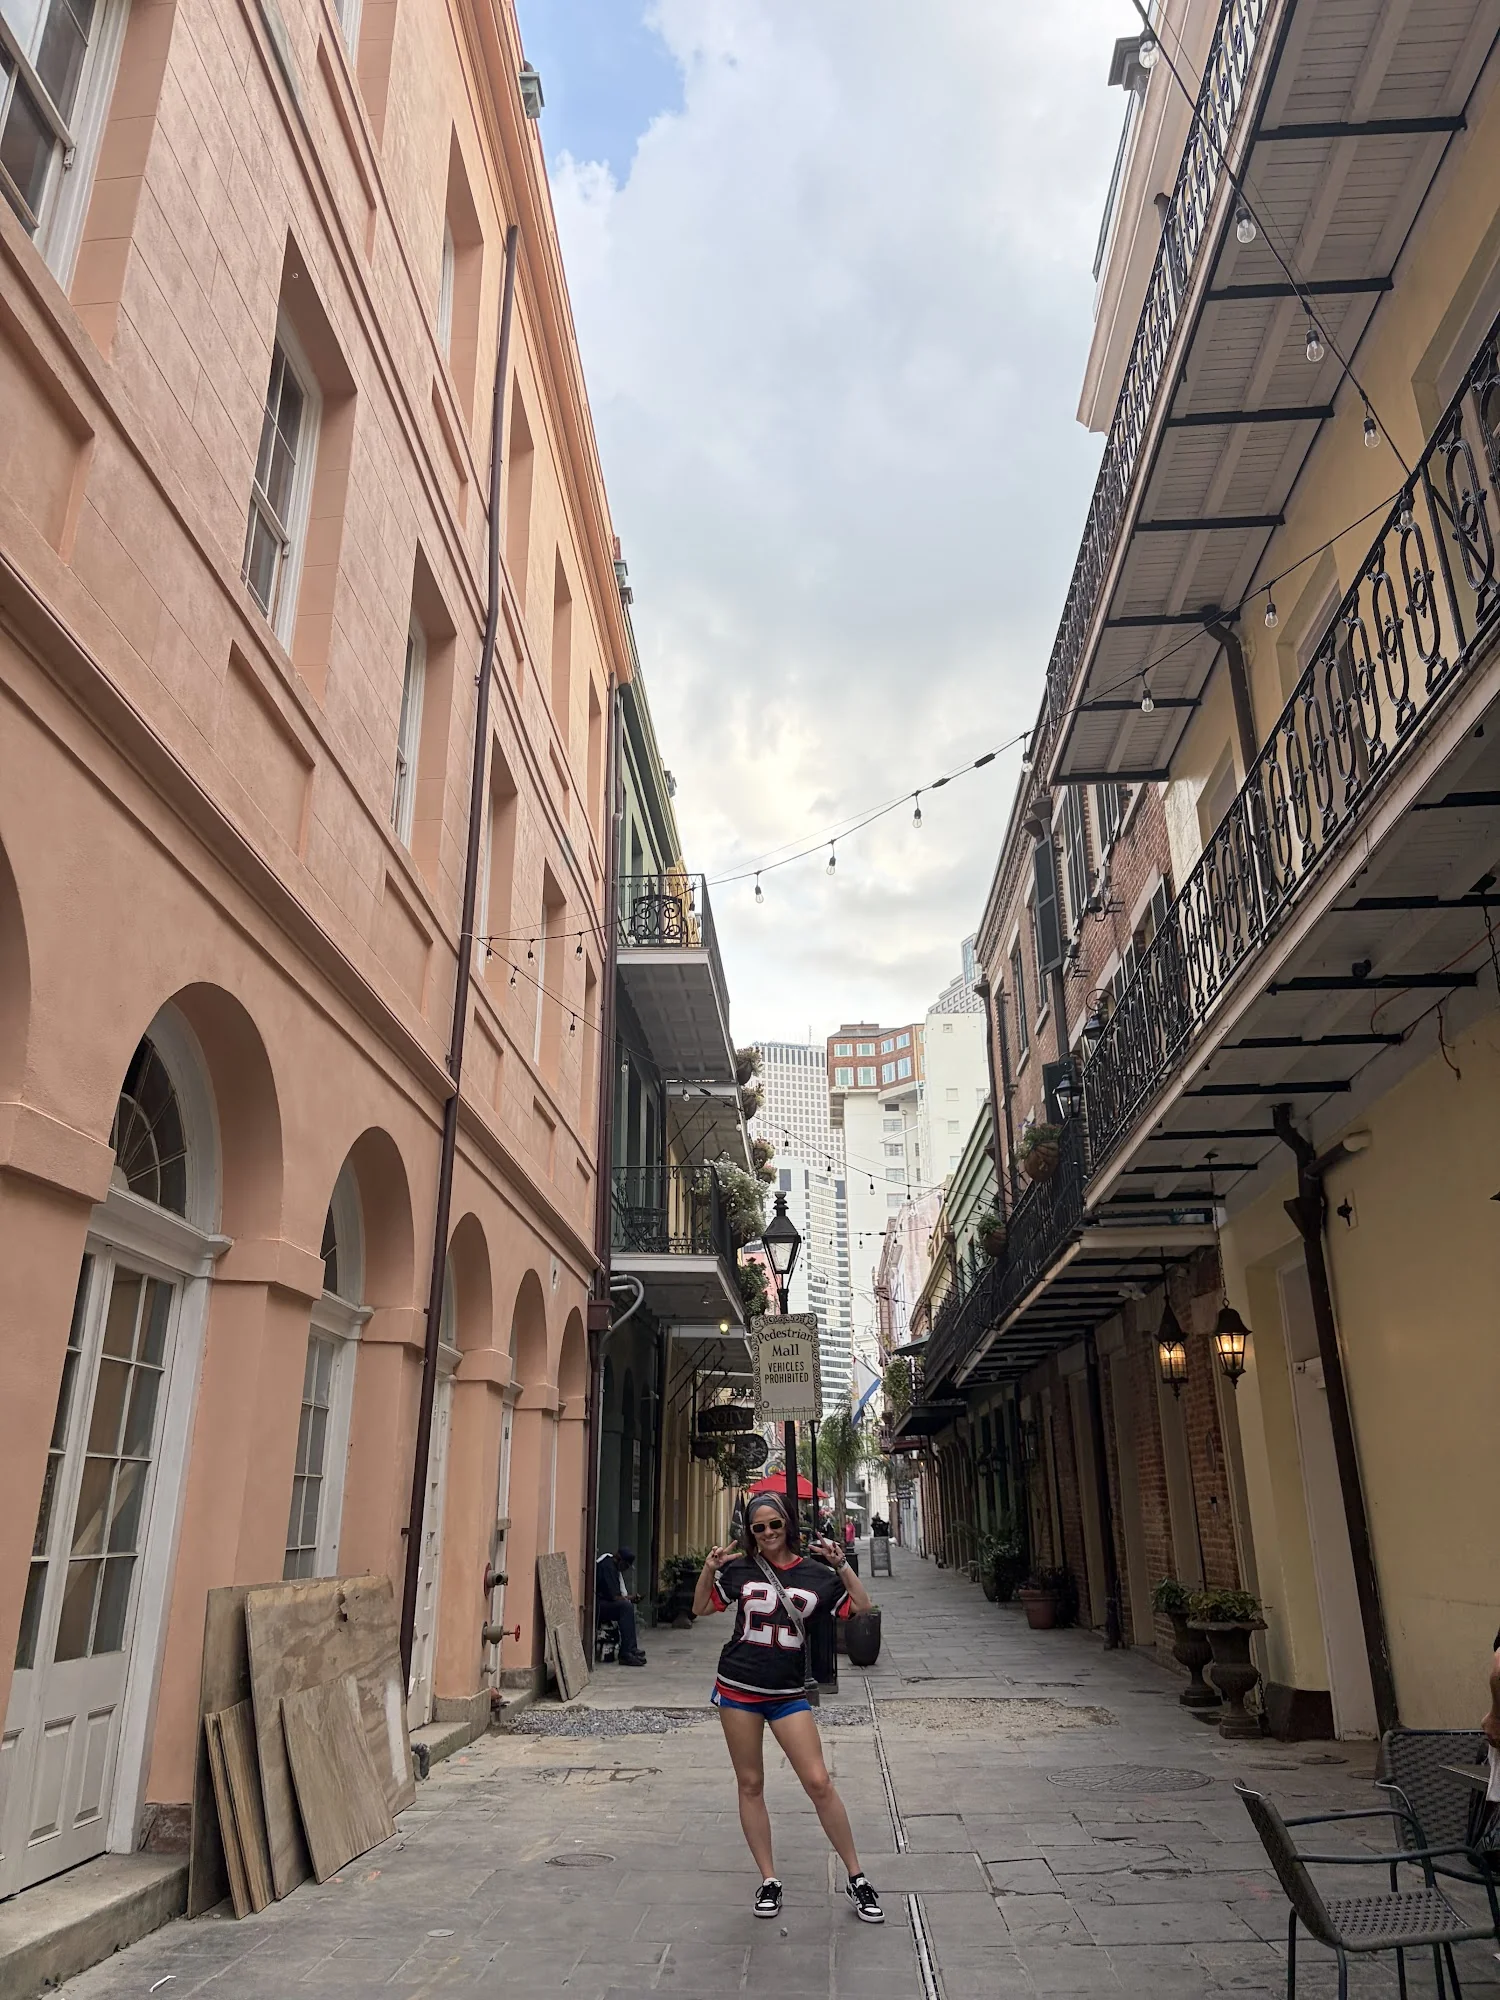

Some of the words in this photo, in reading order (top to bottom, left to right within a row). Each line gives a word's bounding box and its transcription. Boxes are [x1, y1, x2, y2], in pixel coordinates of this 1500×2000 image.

[757, 1327, 813, 1344] Pedestrian
[772, 1343, 800, 1357] Mall
[767, 1361, 805, 1373] VEHICLES
[764, 1372, 809, 1384] PROHIBITED
